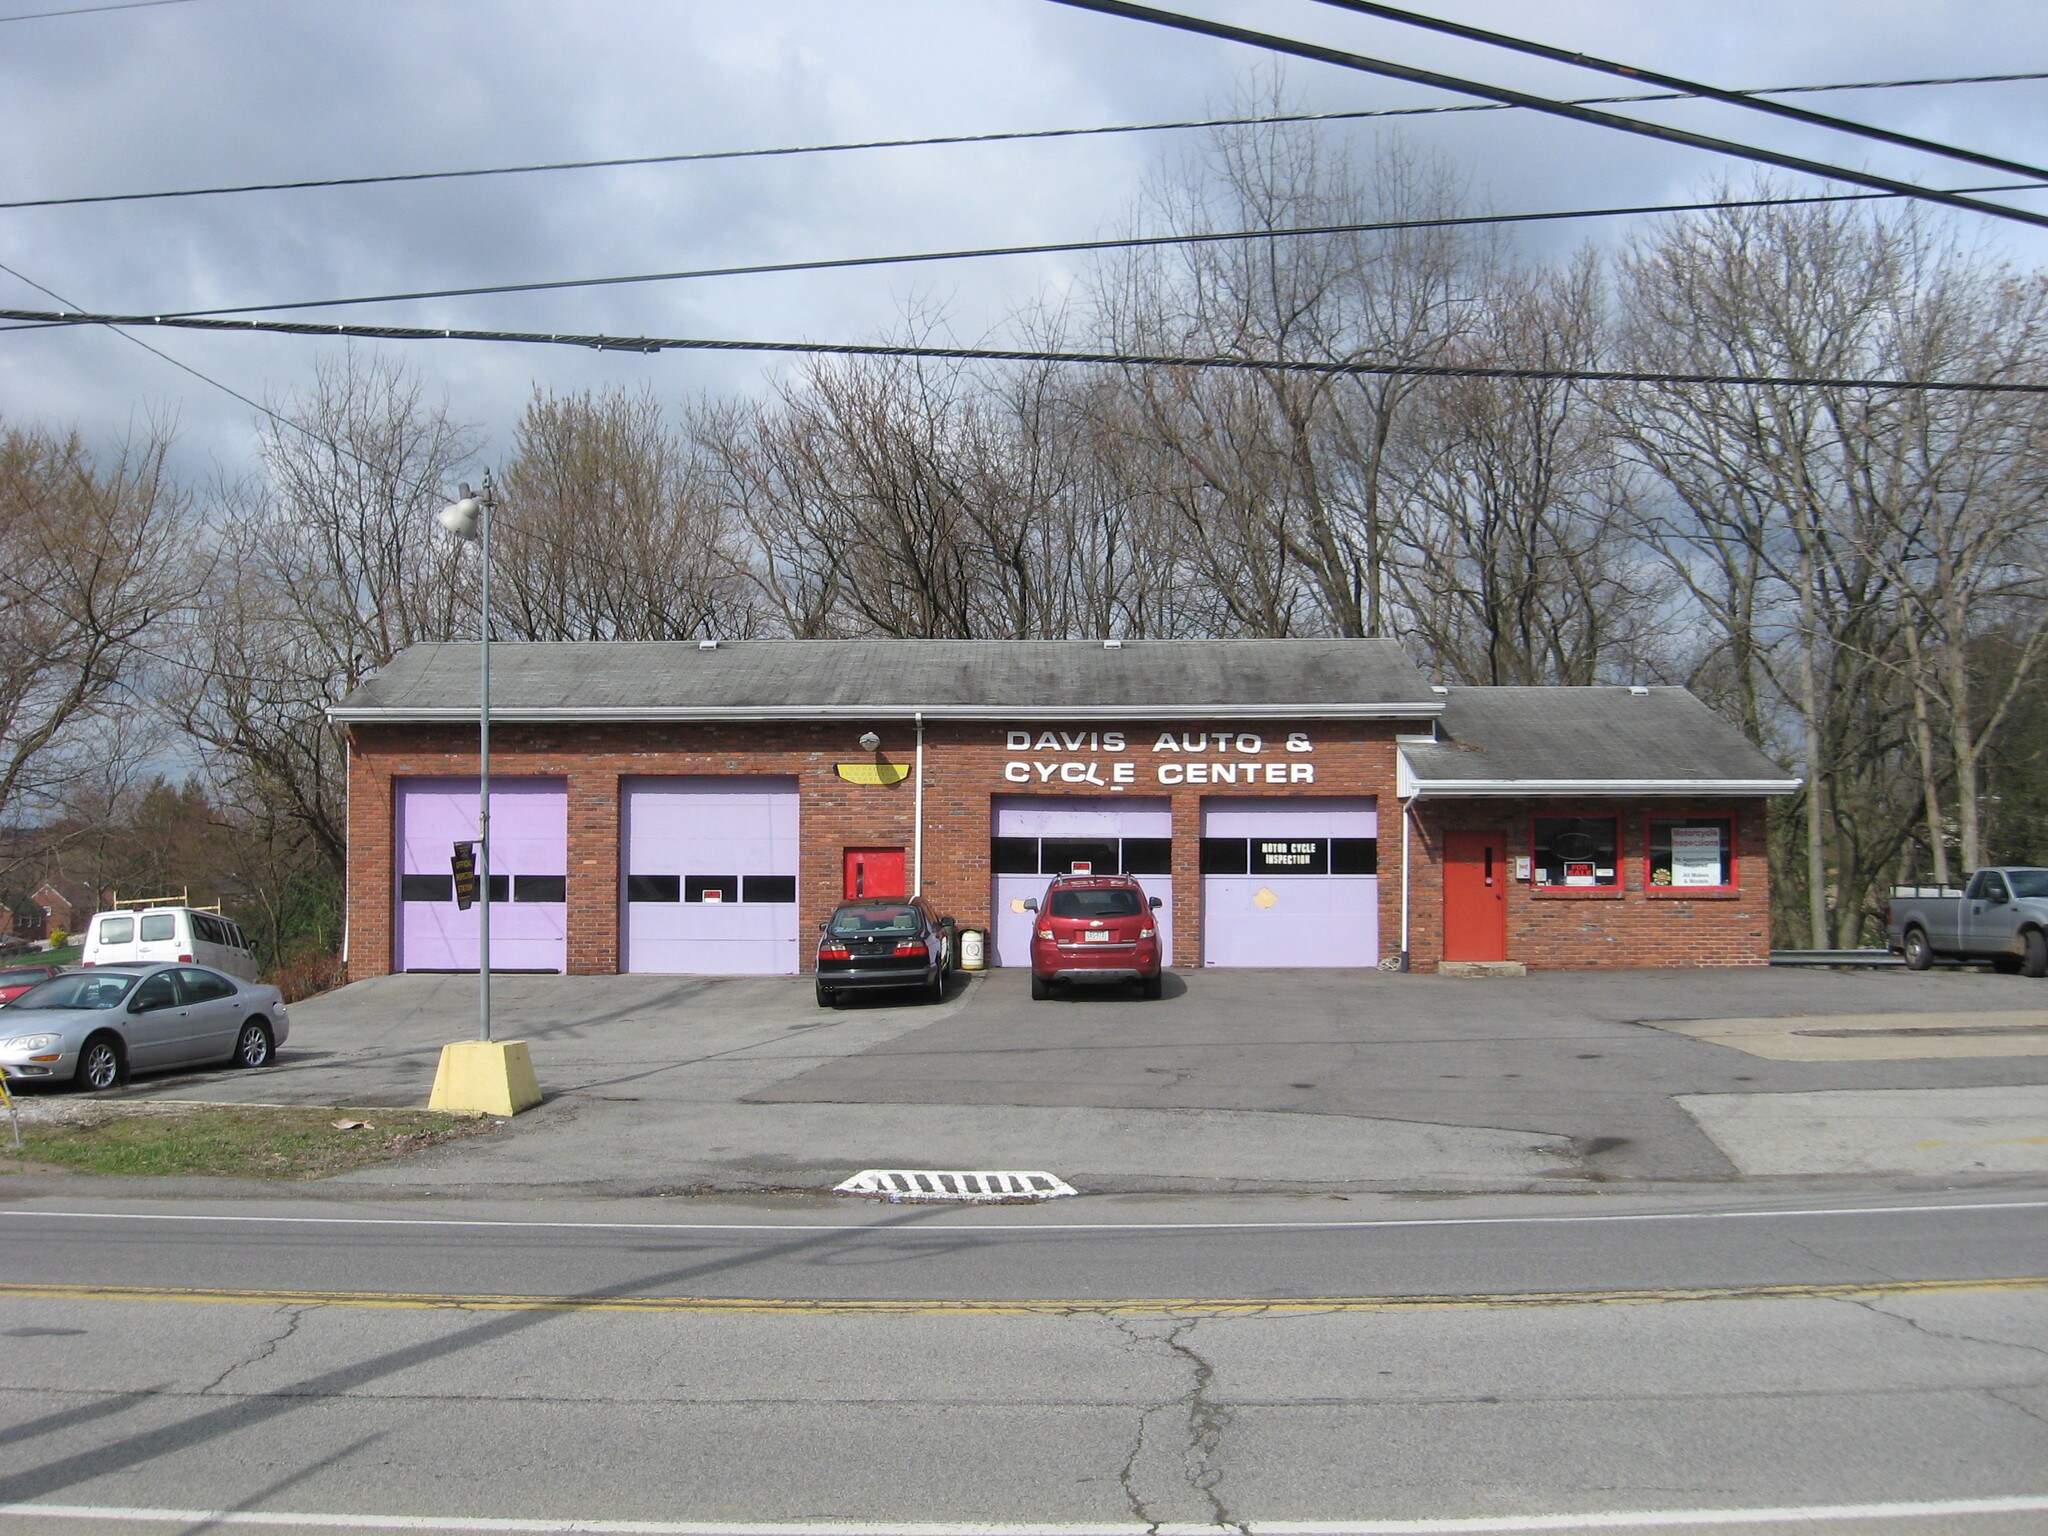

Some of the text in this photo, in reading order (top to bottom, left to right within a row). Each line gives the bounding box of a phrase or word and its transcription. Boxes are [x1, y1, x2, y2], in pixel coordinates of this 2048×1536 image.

[1006, 731, 1313, 754] DAVIS AUTO &
[1004, 761, 1315, 787] CYCLE CENTER
[1672, 829, 1718, 838] Motorcycle
[1261, 843, 1316, 853] MOTOR CYCLE
[1265, 854, 1310, 864] INSPECTION
